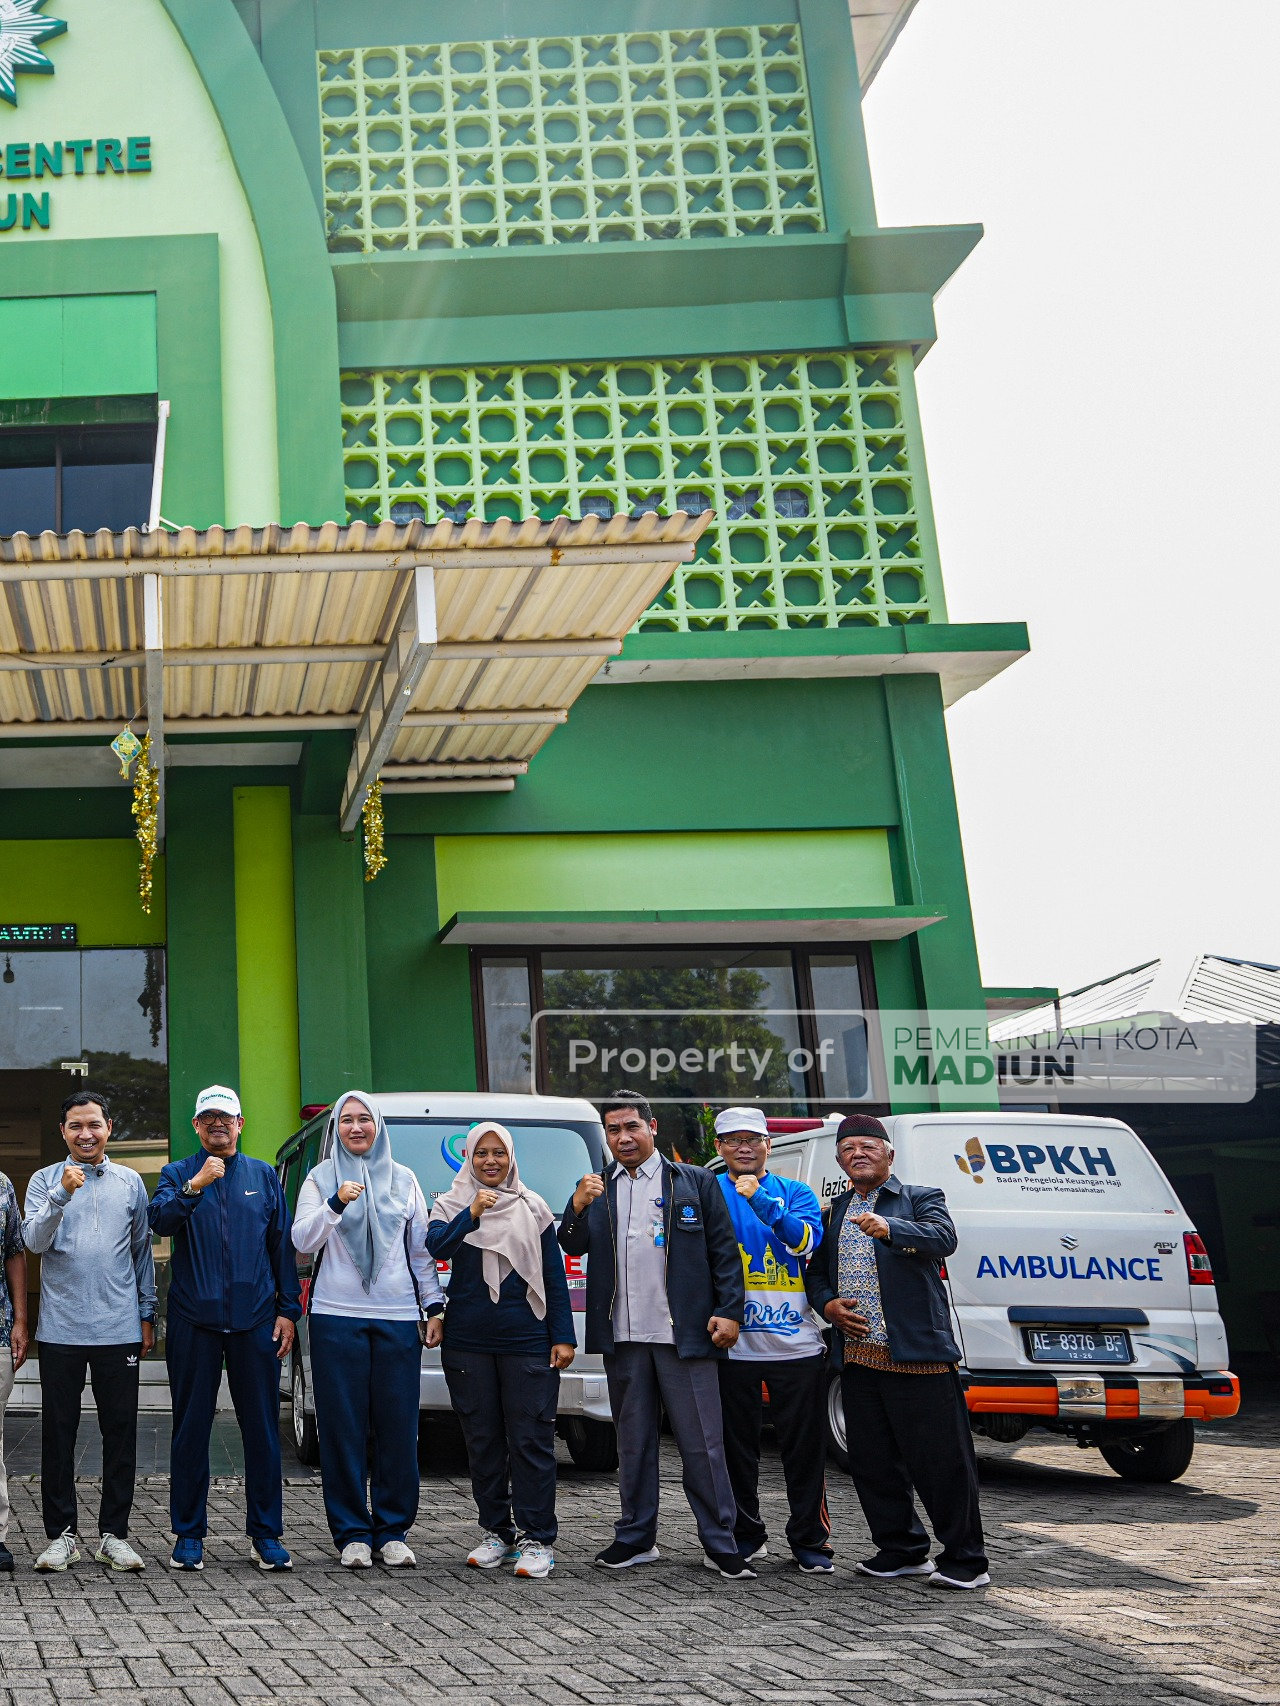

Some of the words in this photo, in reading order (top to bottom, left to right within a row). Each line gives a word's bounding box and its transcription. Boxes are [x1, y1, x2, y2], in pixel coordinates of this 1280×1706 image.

[985, 1144, 1116, 1176] BPKH
[1024, 1176, 1064, 1184] Pengelola
[1065, 1178, 1104, 1186] Keuangan
[1106, 1180, 1121, 1188] Haji
[1054, 1186, 1105, 1194] Kemaslahatan
[976, 1255, 1163, 1281] AMBULANCE
[1033, 1333, 1051, 1350] AE
[1060, 1334, 1095, 1351] 8376
